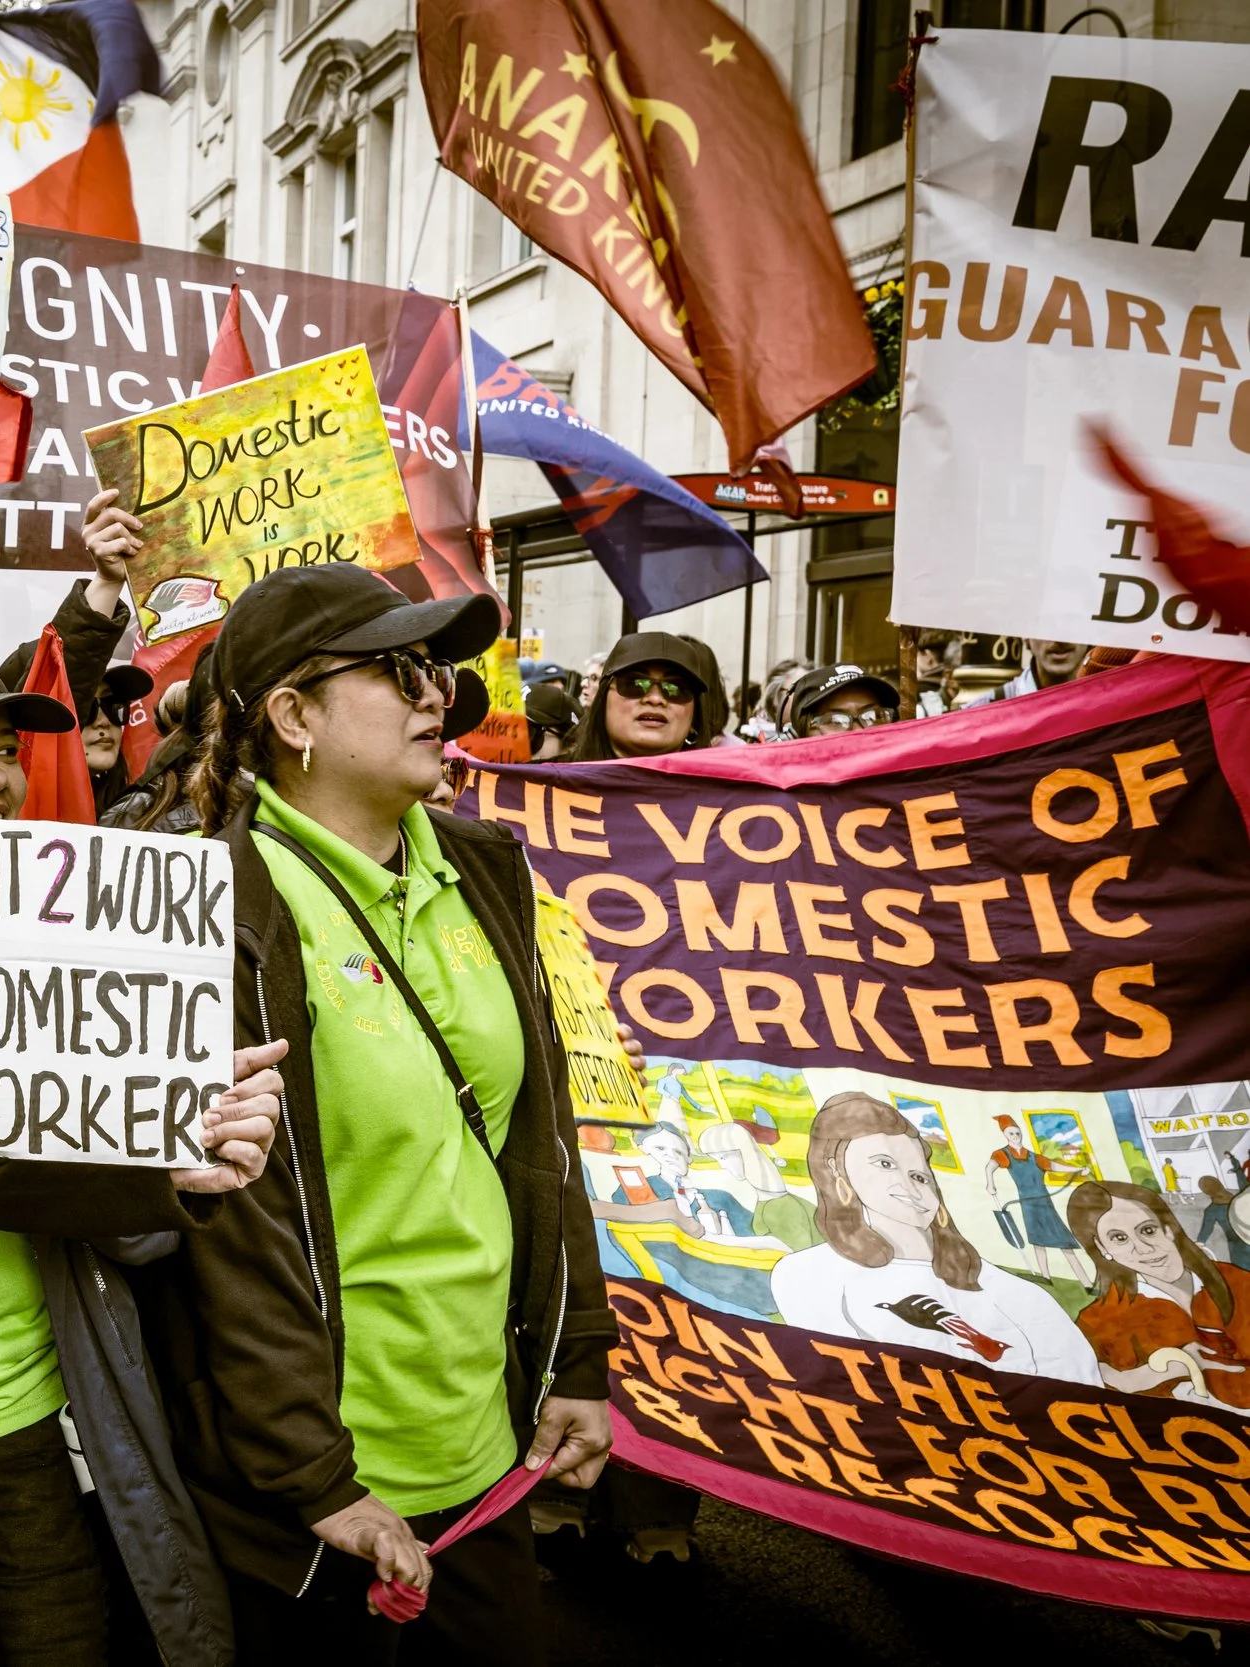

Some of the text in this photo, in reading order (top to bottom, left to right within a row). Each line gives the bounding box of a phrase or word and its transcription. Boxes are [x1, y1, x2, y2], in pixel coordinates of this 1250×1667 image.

[471, 127, 590, 217] UNITED
[906, 259, 1250, 371] GUARA
[197, 468, 322, 546] WORK
[263, 518, 280, 542] is
[635, 790, 972, 871] VOICE
[1031, 739, 1189, 844] OF
[36, 838, 78, 925] 2
[86, 835, 229, 948] WORK
[534, 855, 1153, 968] OMESTIC
[595, 962, 1173, 1069] ORKERS
[621, 1377, 724, 1454] &
[810, 1338, 1030, 1441] THE
[896, 1416, 1138, 1519] FOR
